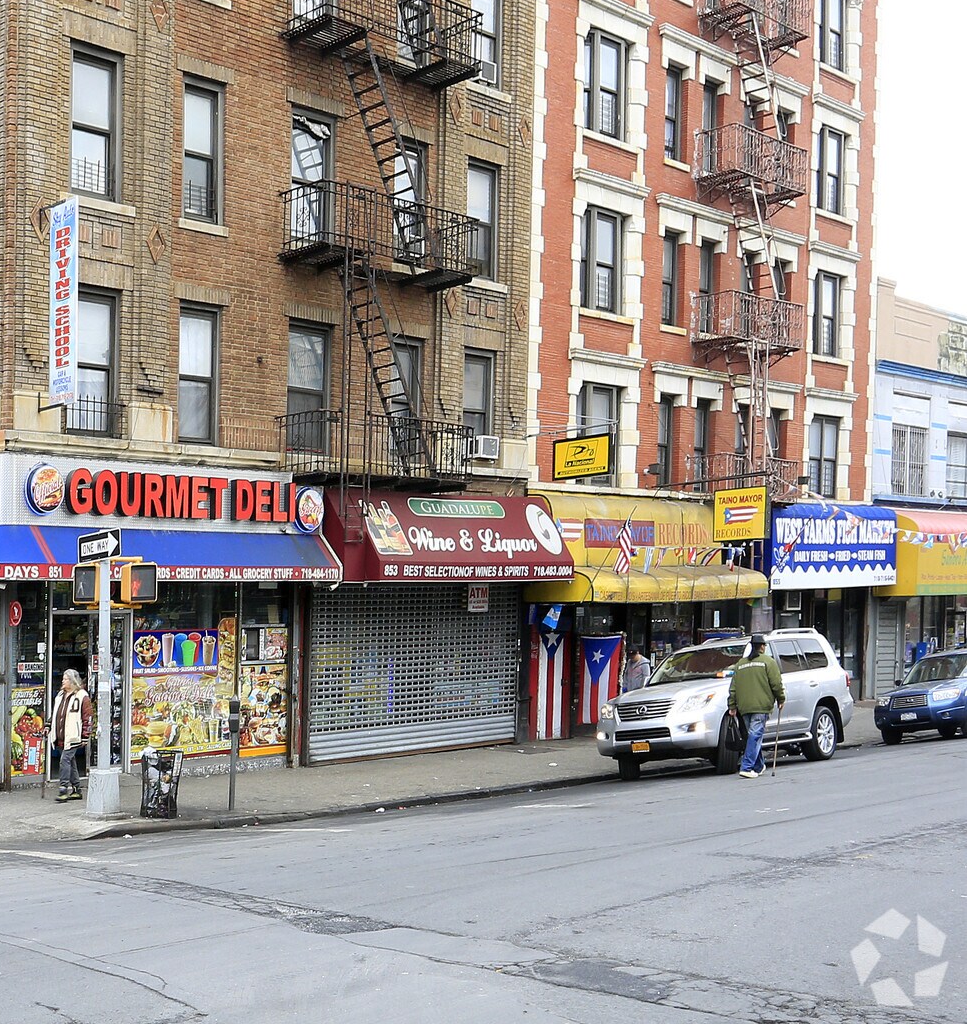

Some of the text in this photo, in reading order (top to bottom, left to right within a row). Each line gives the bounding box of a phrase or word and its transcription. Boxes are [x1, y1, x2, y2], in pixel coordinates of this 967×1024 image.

[56, 226, 72, 369] DRIVING SCHOOL
[70, 468, 296, 522] GOURMET DELI
[718, 494, 763, 504] TAINO MAYOR
[420, 501, 494, 515] GUADALUPE
[659, 523, 708, 545] RECORDS
[716, 528, 751, 538] RECORDS
[776, 518, 802, 544] WEST
[804, 518, 835, 544] FARMS
[82, 540, 108, 555] ONE WAY
[408, 526, 537, 558] Wine & Liquor
[794, 550, 885, 562] DAILY FRESH FRIED STEAM FISH
[4, 566, 39, 578] DAYS
[49, 566, 62, 578] 851
[157, 568, 171, 579] RDS
[176, 568, 200, 579] CREDIT
[202, 568, 224, 579] CARDS
[229, 568, 242, 579] ALL
[243, 568, 273, 579] GROCERY
[274, 568, 293, 579] STUFF
[301, 568, 338, 579] 718-484-1170
[384, 565, 398, 576] 853
[403, 564, 424, 576] BEST
[475, 566, 497, 577] WINES
[498, 566, 503, 576] &
[504, 566, 529, 576] SPIRITS
[470, 588, 488, 598] ATM
